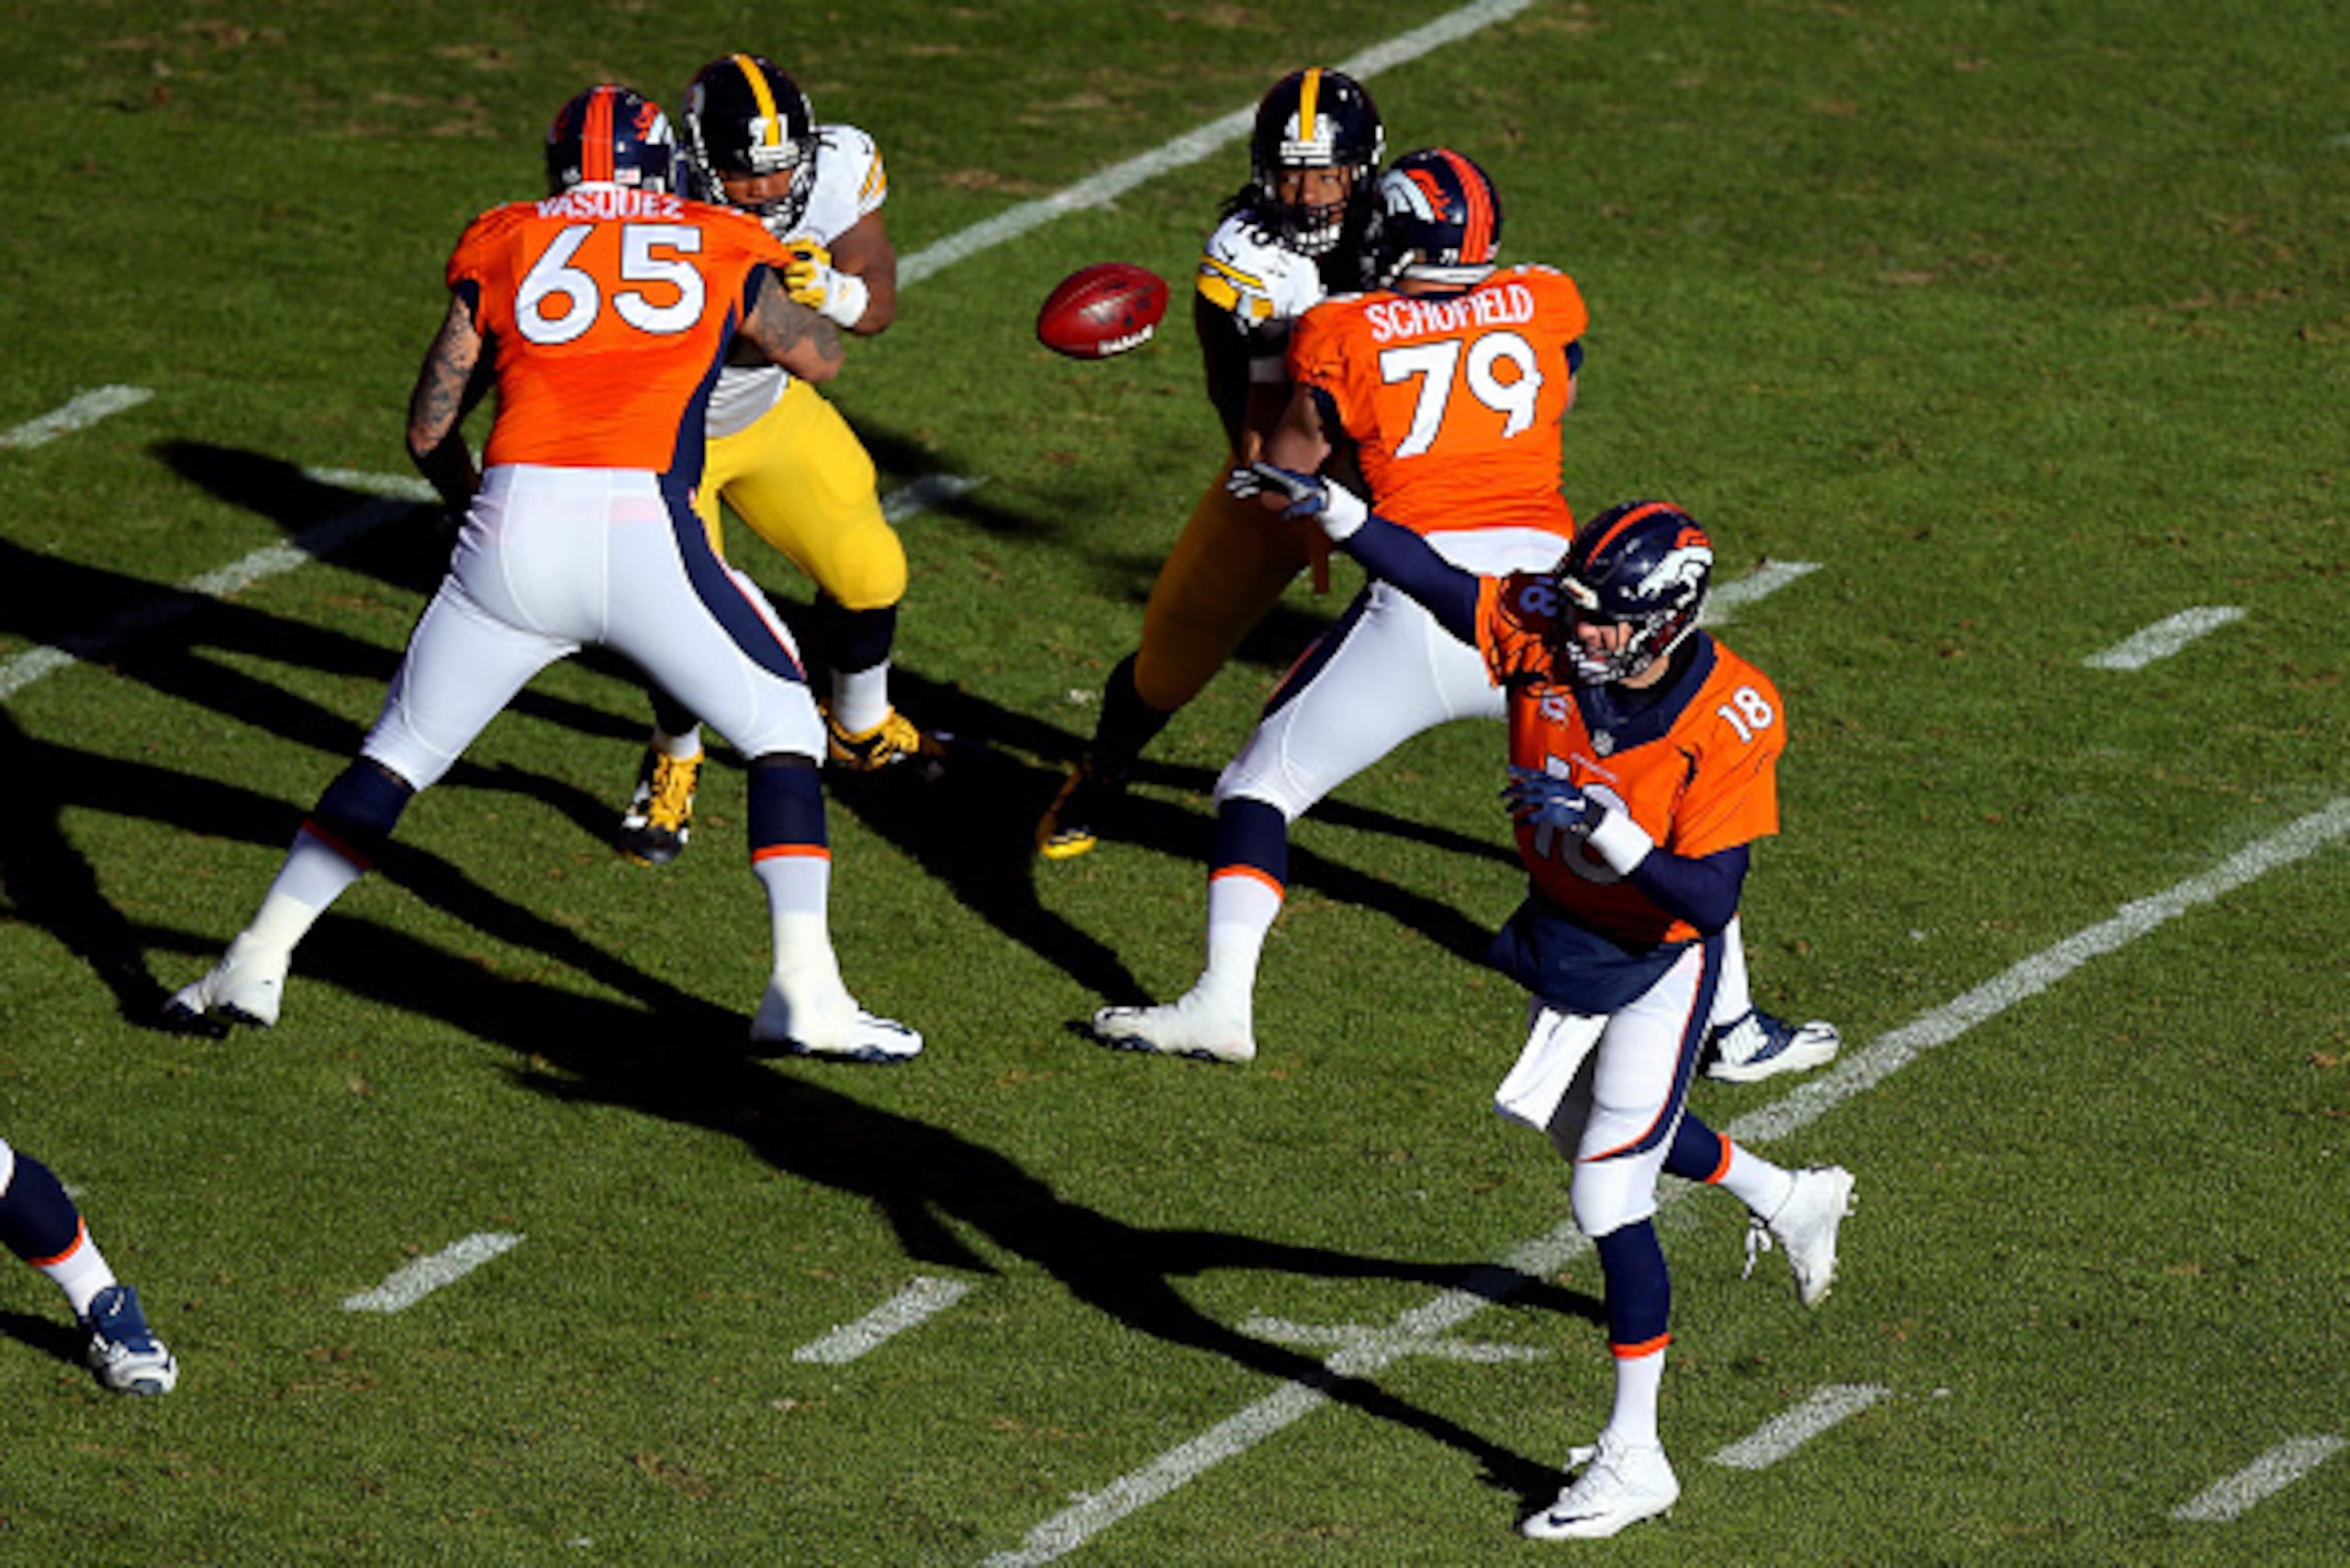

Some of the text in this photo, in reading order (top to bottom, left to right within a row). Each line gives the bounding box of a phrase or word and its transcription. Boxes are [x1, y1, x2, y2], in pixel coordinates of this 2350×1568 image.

[536, 188, 684, 220] VASQUEZ
[515, 223, 705, 343] 65
[1365, 285, 1534, 342] SCHOFIELD
[1380, 330, 1544, 458] 79
[1717, 686, 1774, 744] 18
